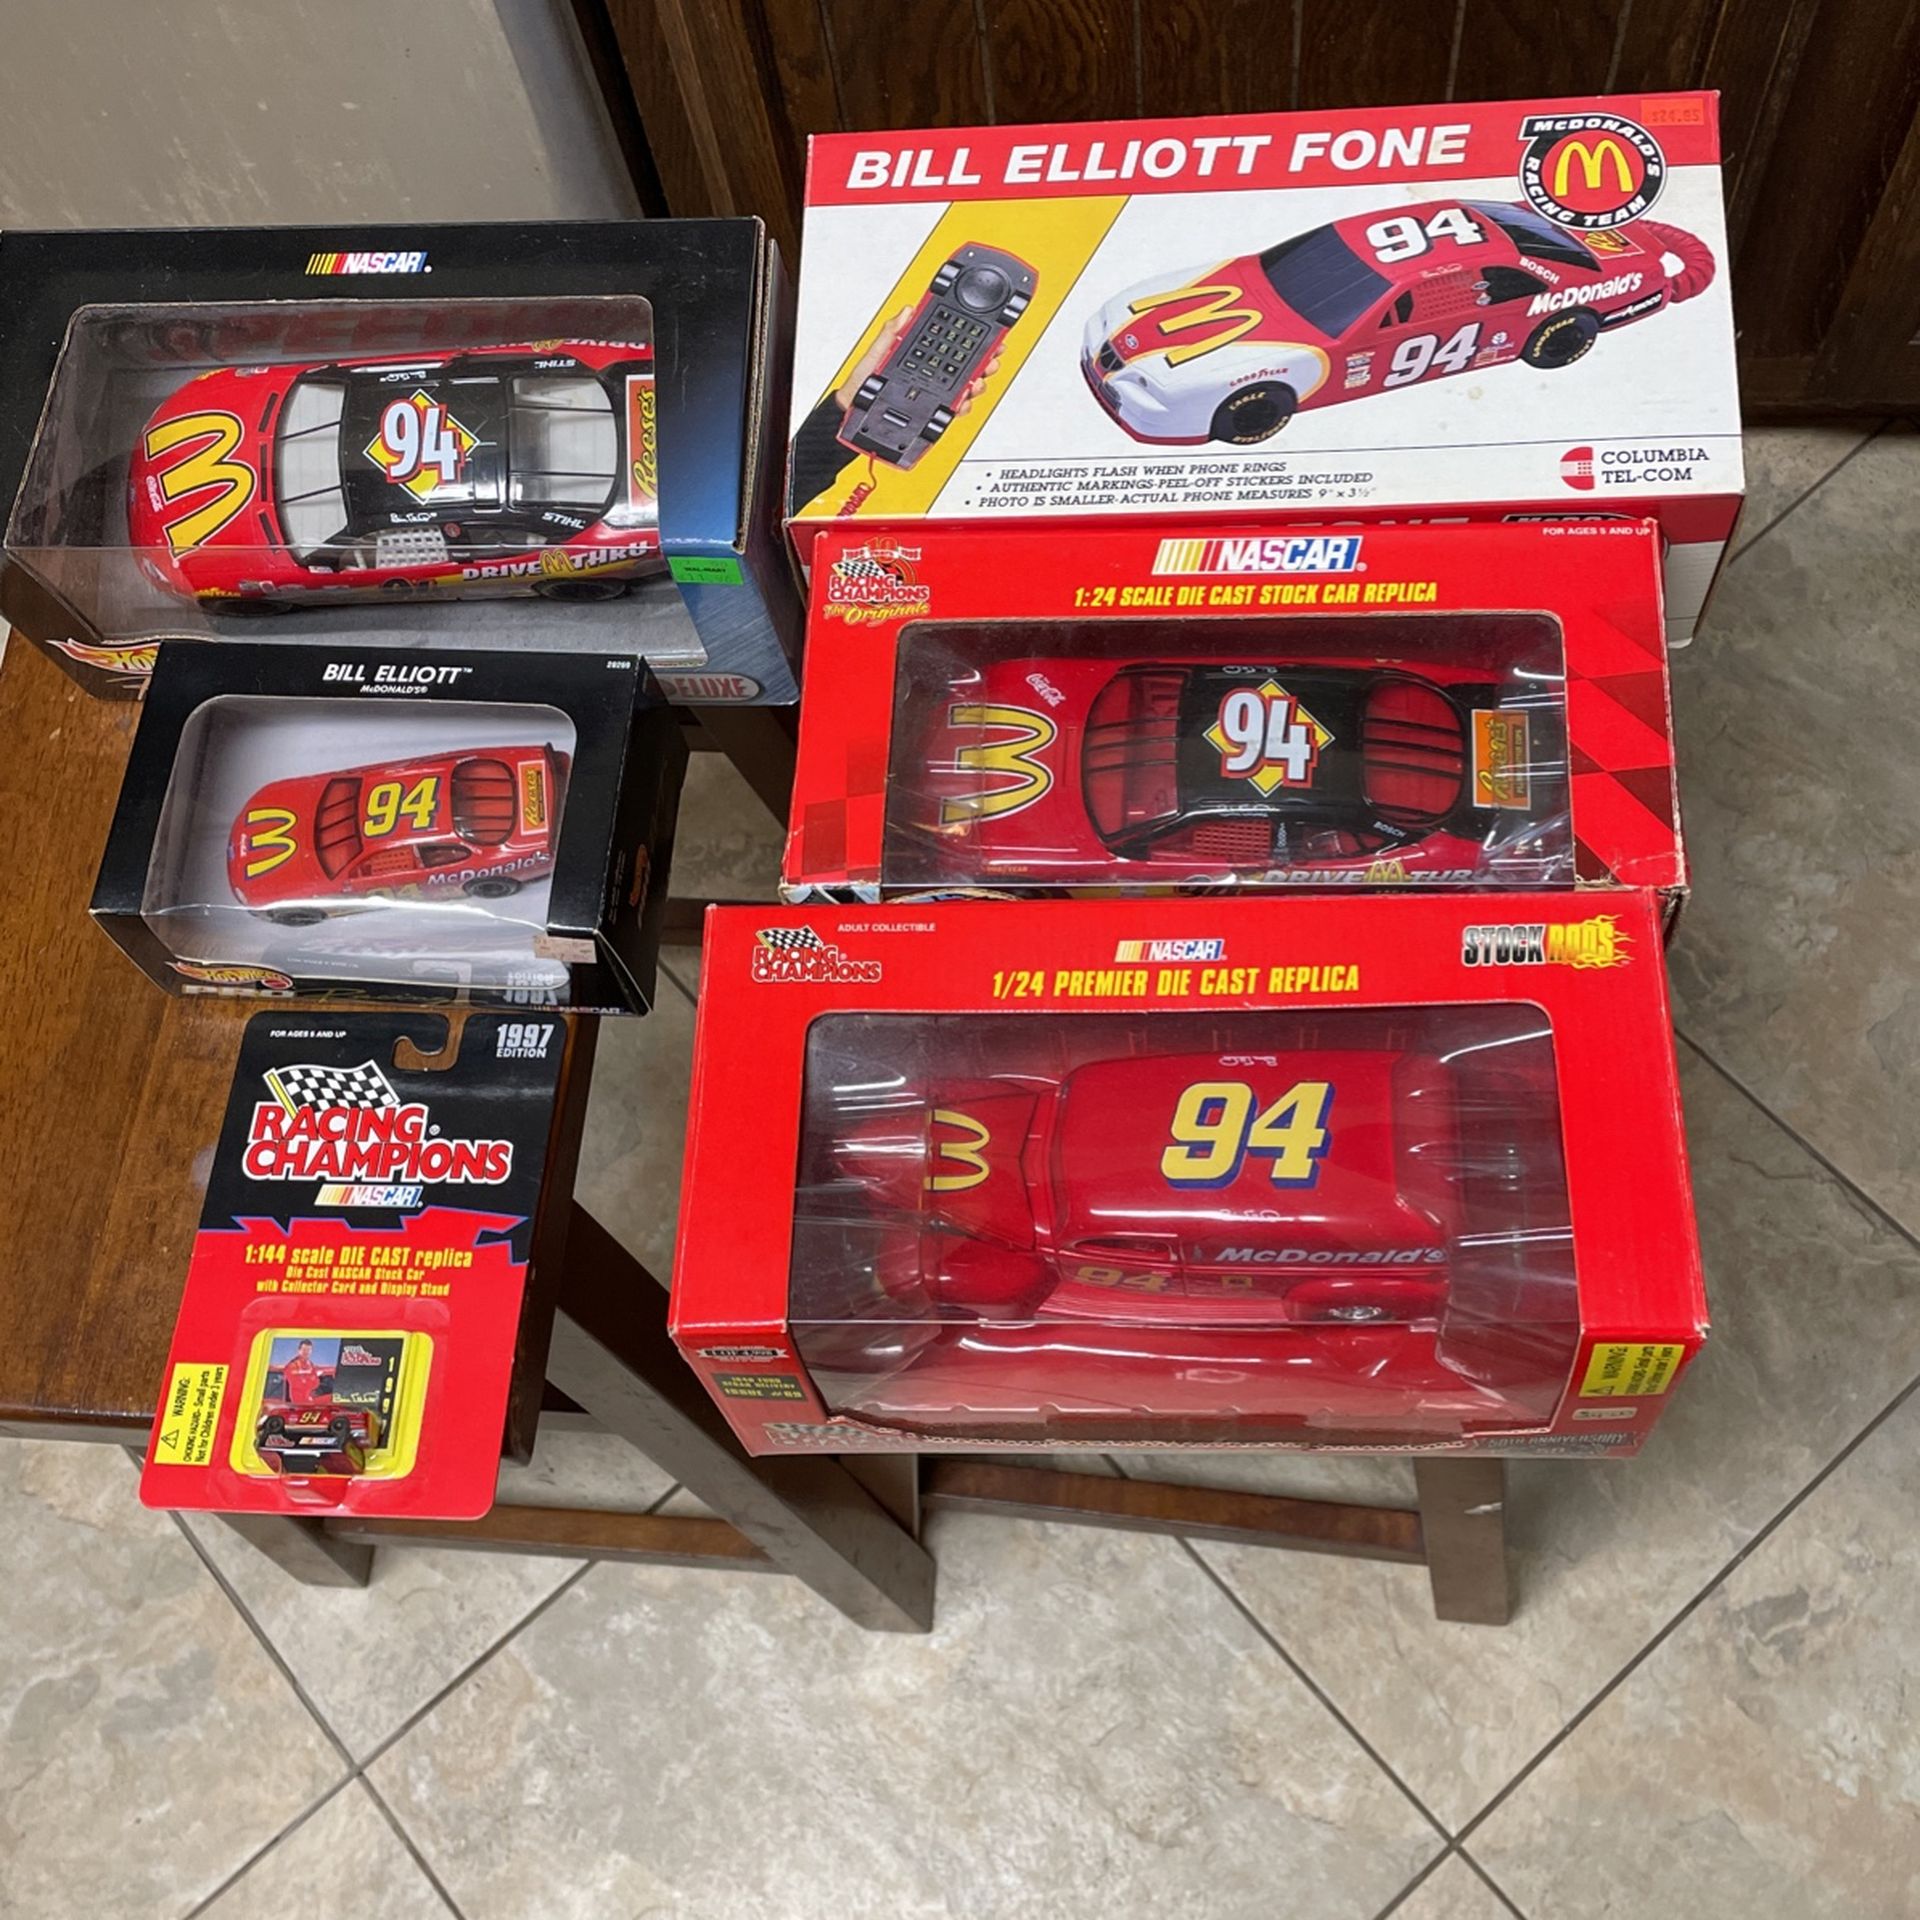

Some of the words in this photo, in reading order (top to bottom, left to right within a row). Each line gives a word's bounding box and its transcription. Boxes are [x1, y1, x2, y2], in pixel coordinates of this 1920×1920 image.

[845, 148, 982, 190] BILL
[1003, 135, 1272, 185] ELLIOTT
[1288, 124, 1472, 173] FONE
[1525, 156, 1576, 222] RACING
[1583, 195, 1648, 227] TEAM
[1366, 208, 1487, 264] 94
[341, 251, 425, 274] NASCAR
[1518, 256, 1561, 285] BOSCH
[1526, 272, 1643, 318] McDonald's
[1383, 322, 1482, 388] 94
[382, 400, 462, 483] 94
[1600, 447, 1710, 466] COLUMBIA
[990, 481, 1073, 493] AUTHENTIC
[1226, 475, 1294, 487] STICKERS
[1297, 473, 1374, 485] INCLUDED
[999, 467, 1089, 480] HEADLIGHTS
[1092, 466, 1138, 478] FLASH
[1143, 464, 1185, 476] WHEN
[1189, 463, 1239, 474] PHONE
[1242, 461, 1288, 473] RINGS
[1601, 467, 1694, 486] TEL-COM
[979, 496, 1029, 508] PHOTO
[1033, 496, 1046, 507] IS
[1182, 491, 1235, 503] PHONE
[1237, 488, 1313, 501] MEASURES
[541, 512, 585, 530] STIHL
[1542, 526, 1565, 535] FOR
[1567, 526, 1597, 535] AGES
[1609, 526, 1634, 535] AND
[1635, 526, 1651, 536] UP
[462, 563, 542, 581] DRIVE
[574, 540, 649, 570] THRU
[1216, 538, 1349, 571] NASCAR
[830, 574, 896, 588] RACING
[829, 587, 930, 601] CHAMPIONS
[1074, 586, 1117, 607] 1:24
[1119, 585, 1173, 607] SCALE
[1176, 585, 1206, 606] DIE
[1208, 584, 1256, 606] CAST
[1259, 583, 1320, 605] STOCK
[1322, 582, 1358, 603] CAR
[1363, 582, 1438, 603] REPLICA
[322, 663, 366, 681] BILL
[1221, 689, 1318, 788] 94
[363, 775, 440, 838] 94
[426, 851, 551, 886] McDonald's
[837, 923, 870, 932] ADULT
[872, 922, 936, 932] COLLECTIBLE
[754, 946, 838, 964] RACING
[1149, 940, 1217, 961] NASCAR
[1463, 925, 1545, 965] STOCK
[754, 963, 881, 981] CHAMPIONS
[992, 970, 1045, 999] 1/24
[1053, 970, 1149, 997] PREMIER
[1157, 969, 1190, 996] DIE
[1200, 968, 1260, 995] CAST
[1268, 965, 1360, 994] REPLICA
[269, 1029, 287, 1038] FOR
[287, 1029, 308, 1038] AGES
[316, 1029, 334, 1038] AND
[335, 1030, 347, 1039] UP
[496, 1023, 554, 1048] 1997
[496, 1047, 547, 1059] EDITION
[251, 1105, 425, 1142] RACING
[1160, 1081, 1335, 1190] 94
[245, 1141, 510, 1179] CHAMPIONS
[350, 1186, 416, 1206] NASCAR
[245, 1244, 286, 1264] 1:144
[291, 1247, 334, 1265] scale
[339, 1246, 365, 1266] DIE
[370, 1247, 410, 1267] CAST
[415, 1248, 473, 1270] replica
[1214, 1246, 1447, 1265] McDonald's
[286, 1265, 303, 1278] Die
[305, 1266, 329, 1279] Cast
[332, 1266, 372, 1280] NASCAR
[375, 1267, 403, 1280] Stock
[406, 1268, 425, 1281] Car
[256, 1279, 278, 1292] with
[281, 1280, 329, 1294] Collector
[332, 1281, 355, 1294] Card
[359, 1281, 377, 1295] and
[381, 1282, 418, 1297] Display
[420, 1283, 450, 1296] Stand
[172, 1377, 191, 1417] WARNING:
[193, 1387, 206, 1407] Small
[200, 1370, 210, 1387] parts
[200, 1411, 214, 1437] Children
